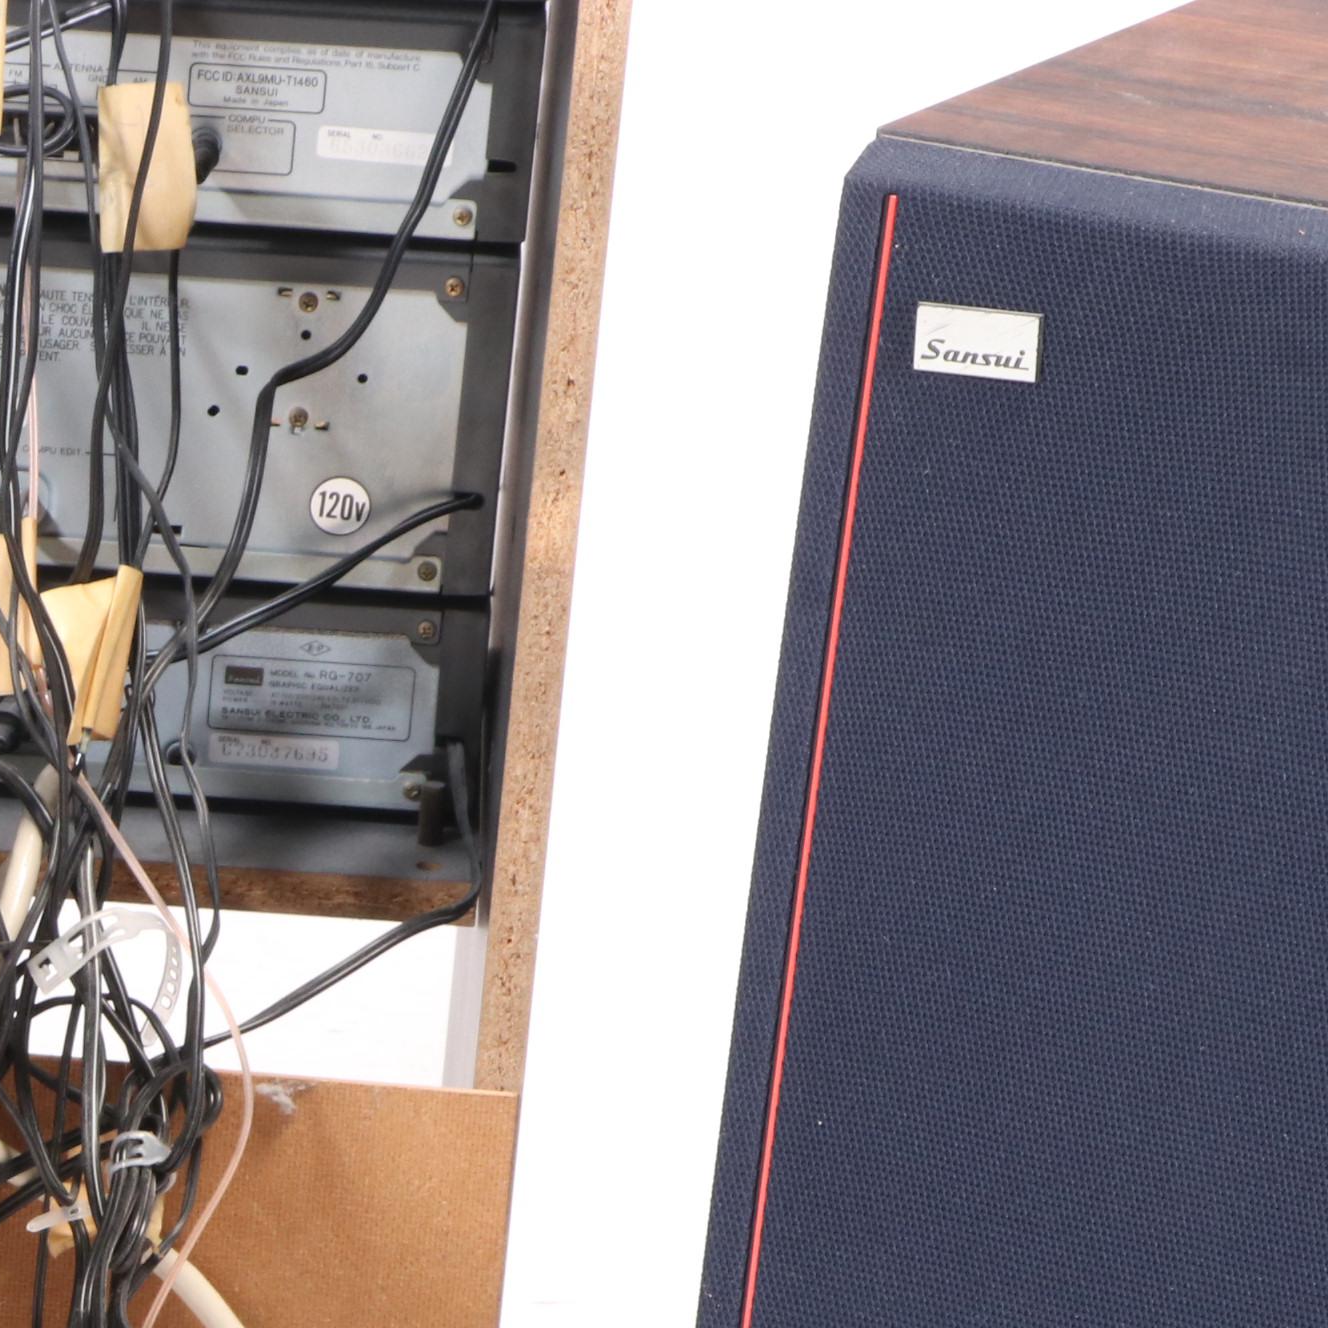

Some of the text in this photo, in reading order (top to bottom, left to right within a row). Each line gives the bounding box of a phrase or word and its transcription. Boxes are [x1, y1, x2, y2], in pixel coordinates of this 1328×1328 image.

[197, 69, 221, 82] FCC
[235, 86, 278, 97] SANSUI
[224, 96, 246, 104] Made
[264, 99, 289, 107] Japan
[227, 125, 285, 136] SELECTOR
[920, 338, 1030, 371] Sansui
[319, 670, 373, 683] RG-707
[268, 680, 360, 693] GRAPHIC EQUALIZER
[221, 707, 319, 721] SANSUI ELECTRIC
